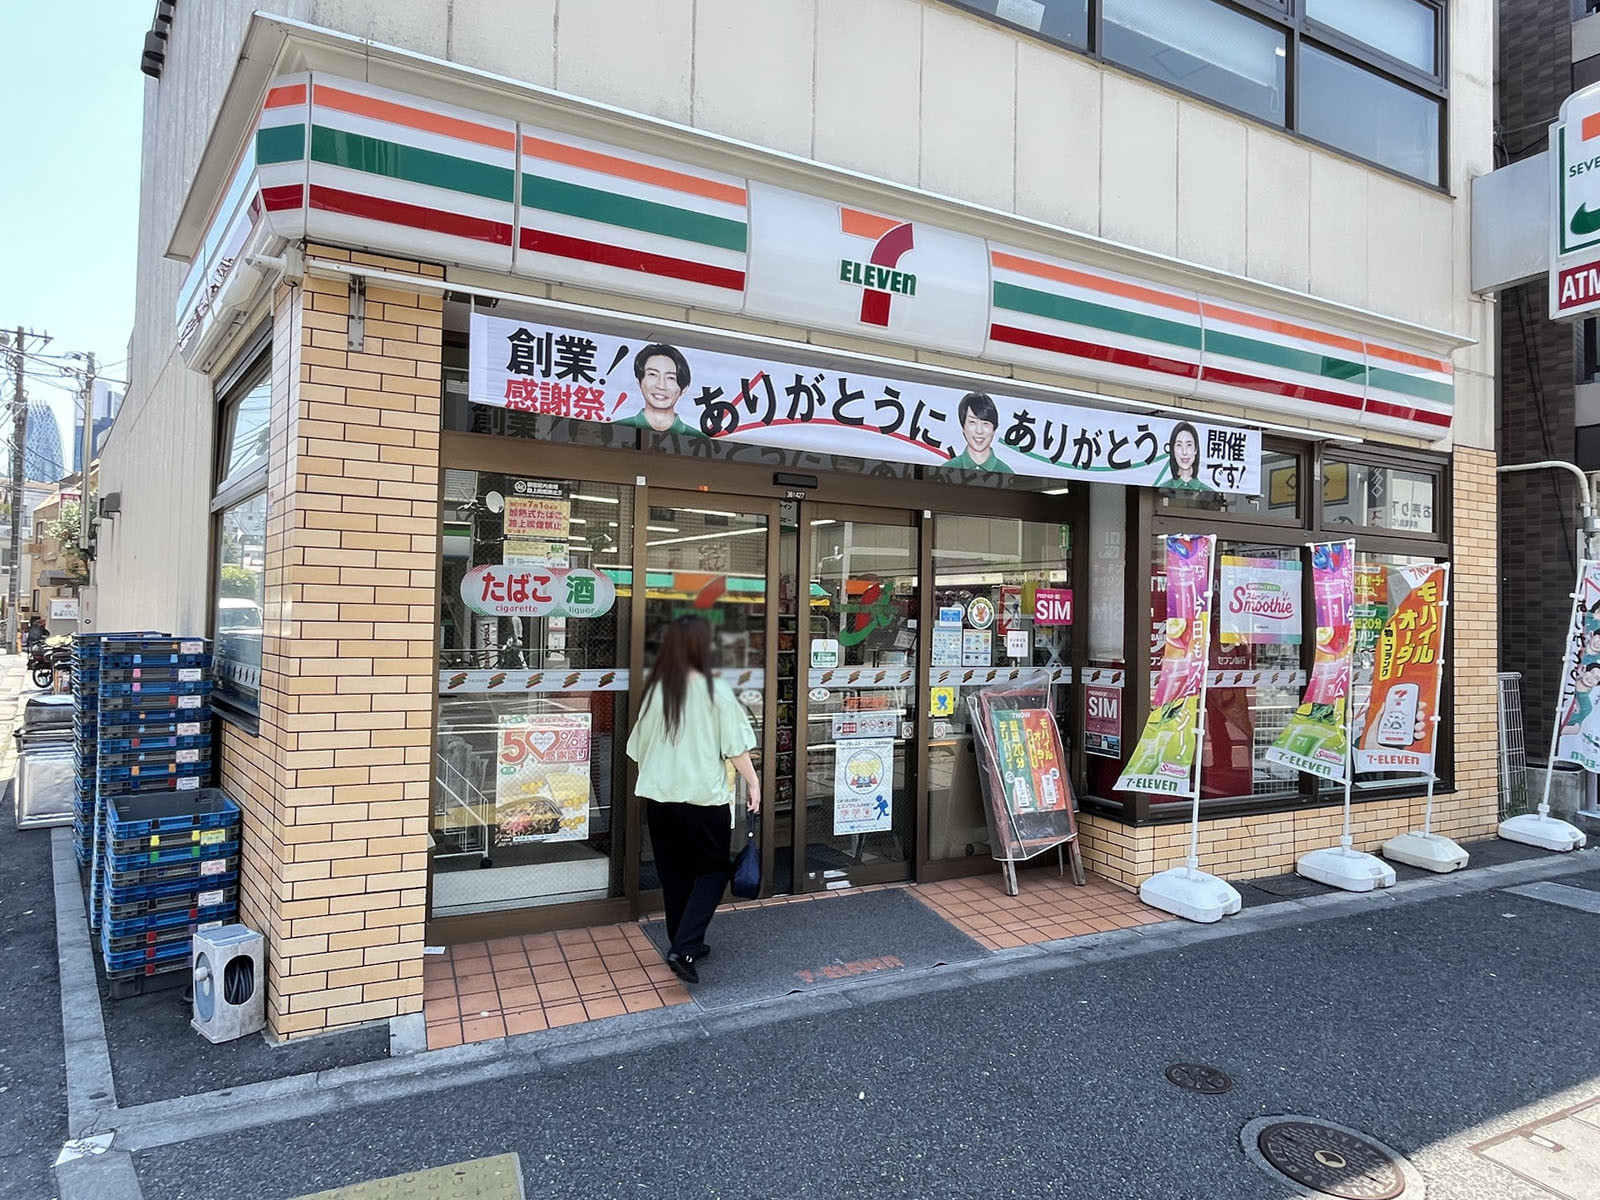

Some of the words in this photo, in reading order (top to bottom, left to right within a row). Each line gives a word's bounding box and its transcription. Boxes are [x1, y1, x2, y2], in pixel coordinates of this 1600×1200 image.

[507, 327, 629, 385] 創業!
[504, 378, 628, 421] 感謝祭!
[1207, 429, 1246, 462] 開催
[1207, 463, 1246, 489] です!
[481, 572, 552, 602] たばこ
[566, 575, 595, 605] 酒
[1229, 586, 1293, 614] Smoothie
[495, 604, 538, 613] cigarette
[568, 606, 595, 614] liquor
[1036, 600, 1070, 620] SIM
[1413, 582, 1438, 664] モバイル
[1396, 610, 1419, 678] オーダー
[1088, 697, 1118, 719] SIM
[1126, 778, 1178, 792] 7-ELEVEn
